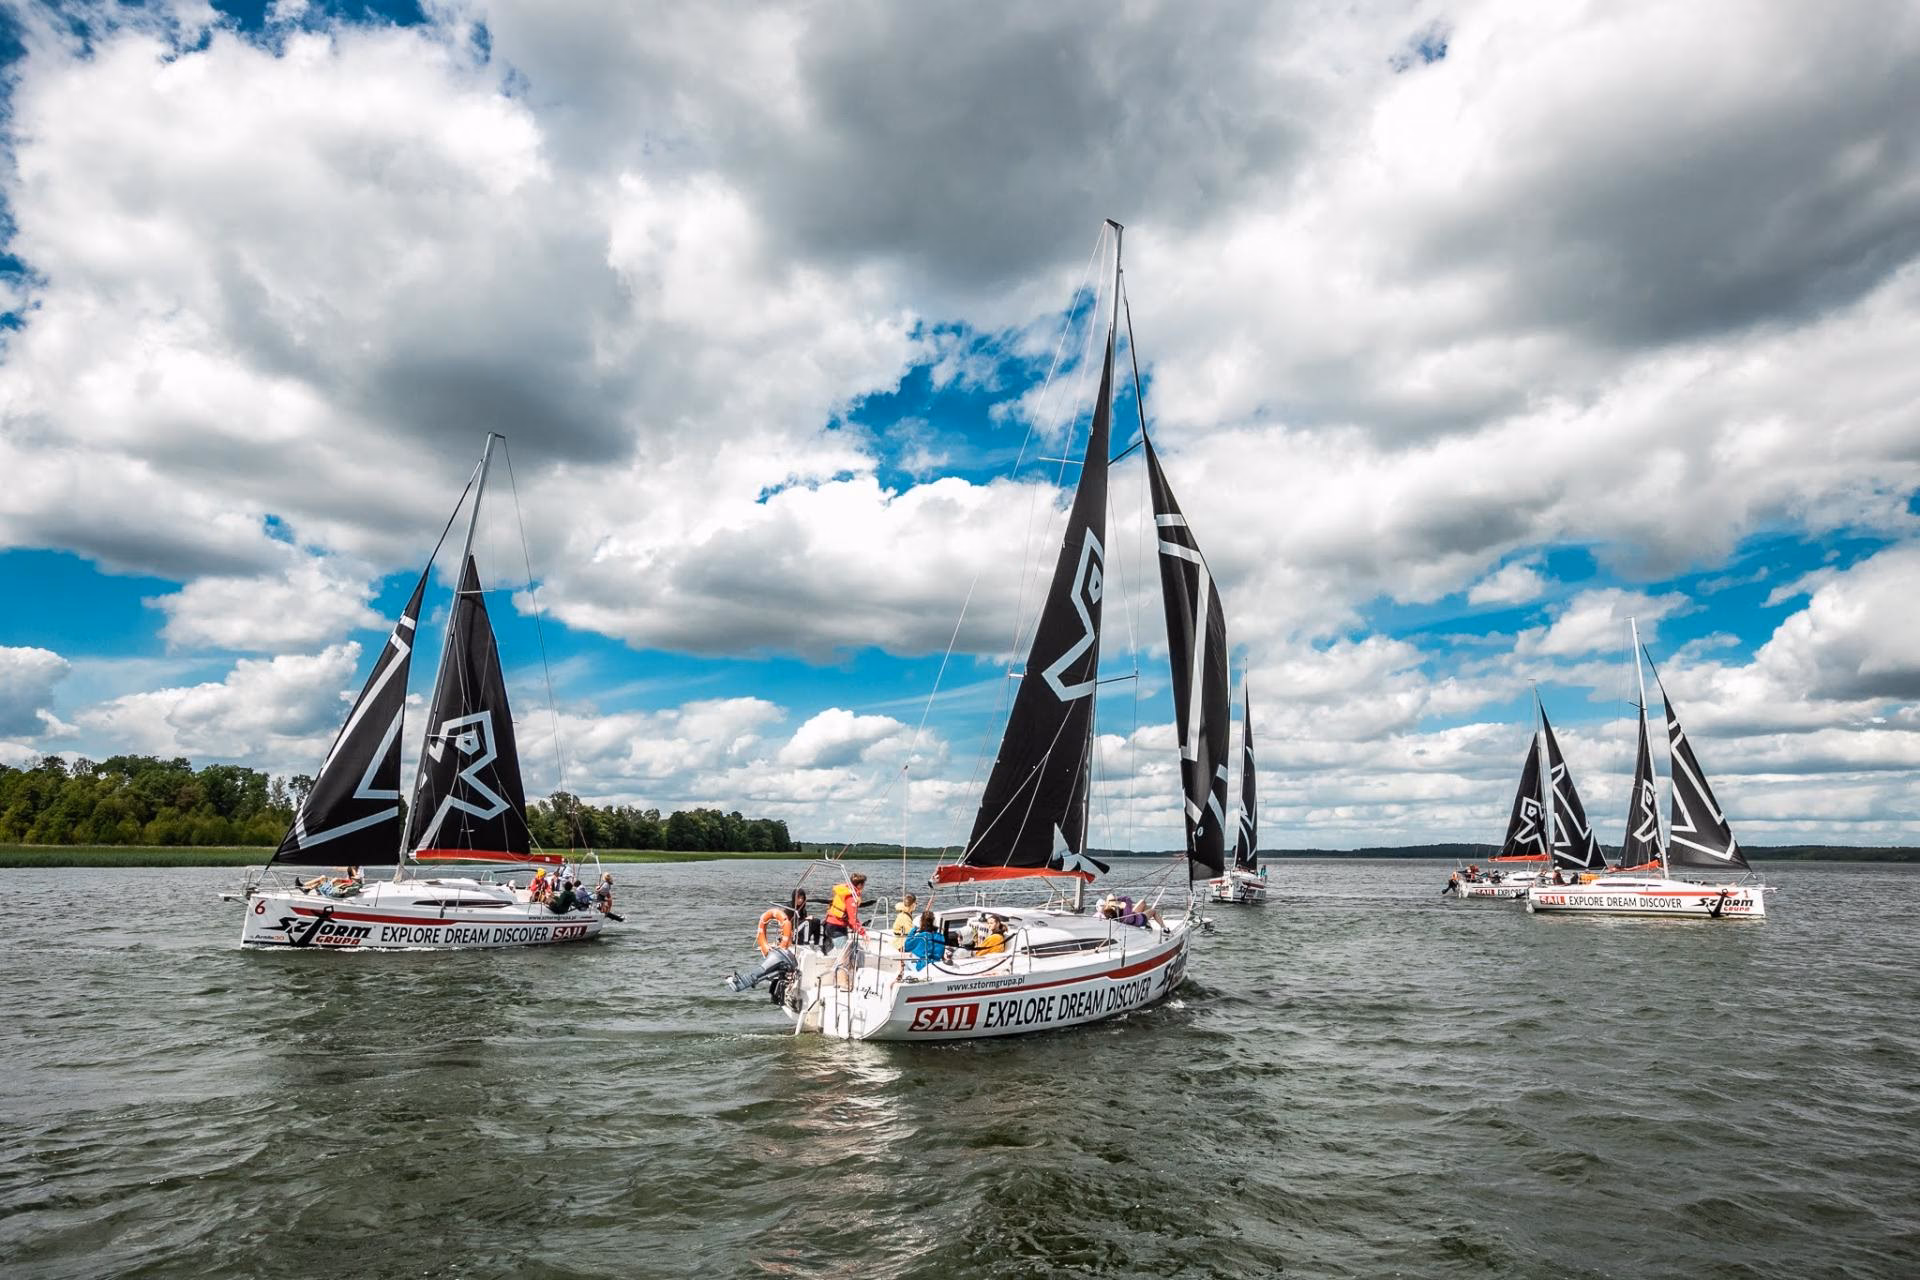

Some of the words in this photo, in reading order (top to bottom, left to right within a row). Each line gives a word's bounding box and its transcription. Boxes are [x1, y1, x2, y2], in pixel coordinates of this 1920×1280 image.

[254, 900, 266, 915] 6
[1540, 896, 1566, 905] SAIL
[1569, 896, 1604, 906] EXPLORE
[1607, 897, 1637, 907] DREAM
[1639, 897, 1682, 908] DISCOVER
[380, 926, 442, 943] EXPLORE
[444, 928, 491, 944] DREAM
[493, 927, 549, 943] DISCOVER
[552, 926, 584, 940] SAIL
[946, 976, 1025, 991] www.sztormgrupa.pl
[913, 1005, 974, 1030] SAIL
[983, 996, 1055, 1028] EXPLORE
[1057, 989, 1105, 1020] DREAM
[1106, 977, 1152, 1011] DISCOVER
